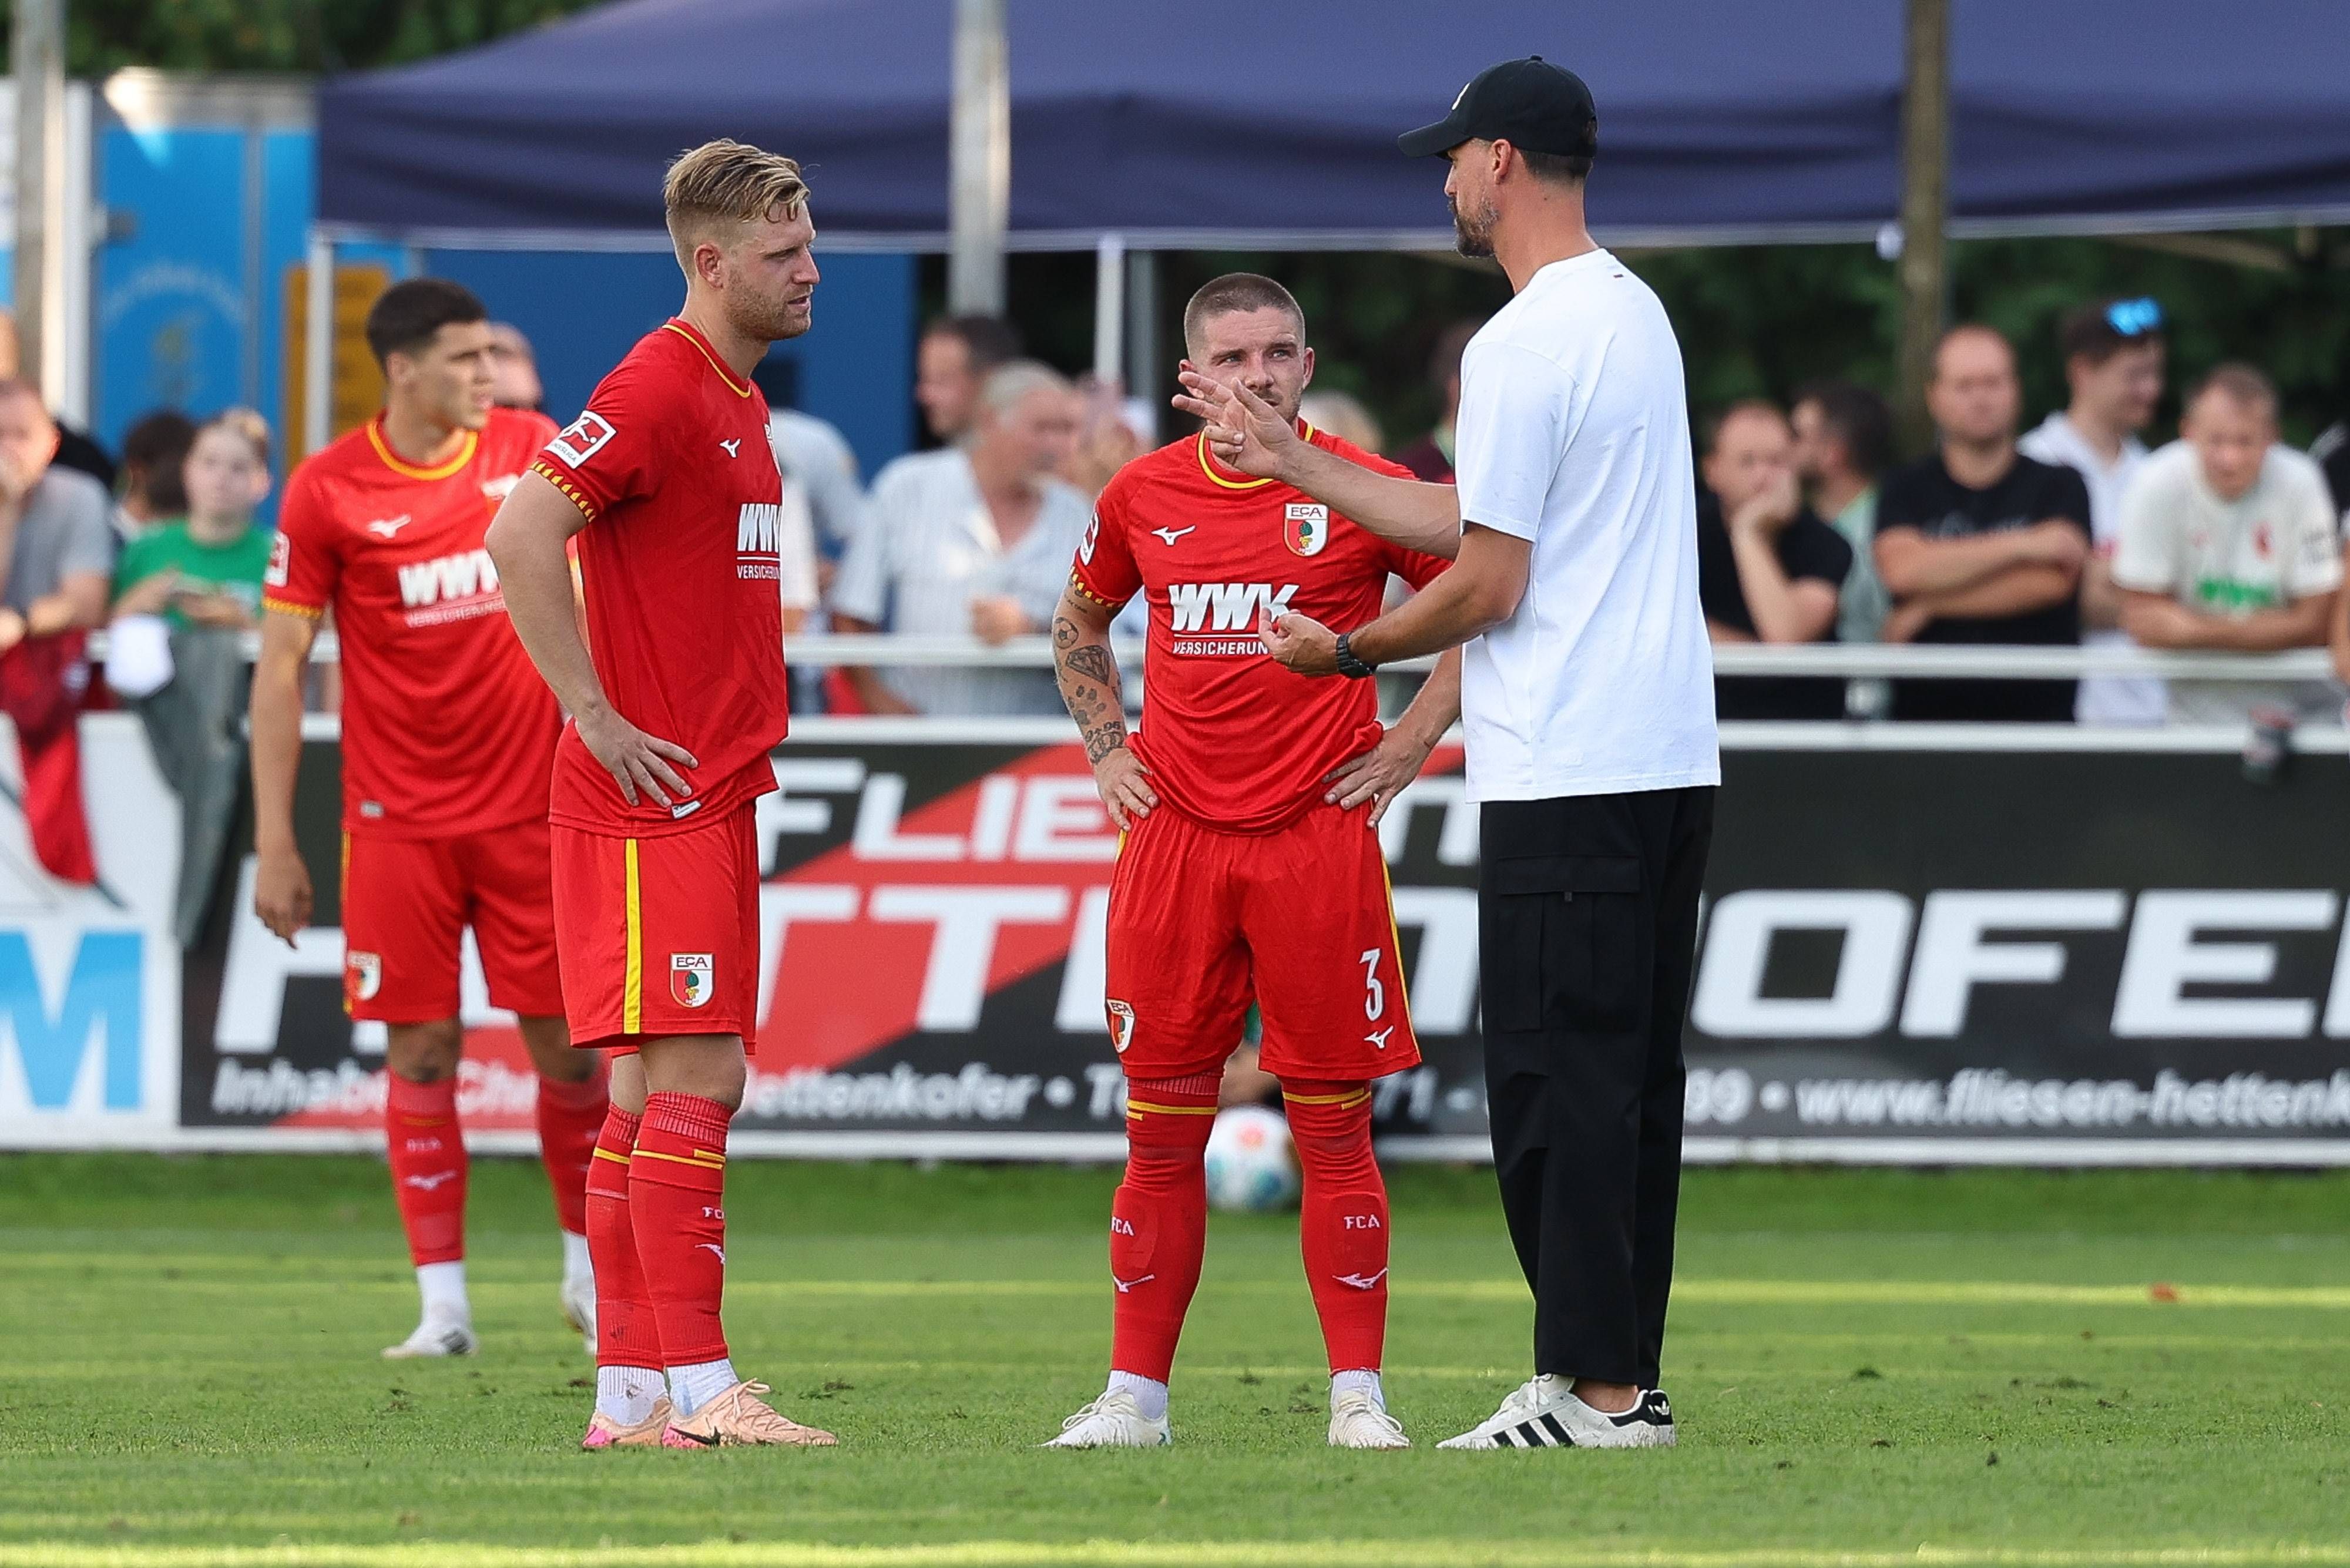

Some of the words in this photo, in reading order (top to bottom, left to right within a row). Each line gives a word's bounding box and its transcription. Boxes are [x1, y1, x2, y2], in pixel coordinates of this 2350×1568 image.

[1168, 583, 1300, 632] WWK
[1173, 641, 1268, 656] VERSICHERUN
[1359, 948, 1382, 1021] 3
[739, 1062, 1041, 1119] ettenkofer
[1794, 1067, 2350, 1127] www.fliesen-hettenk
[1343, 1214, 1380, 1230] FCA
